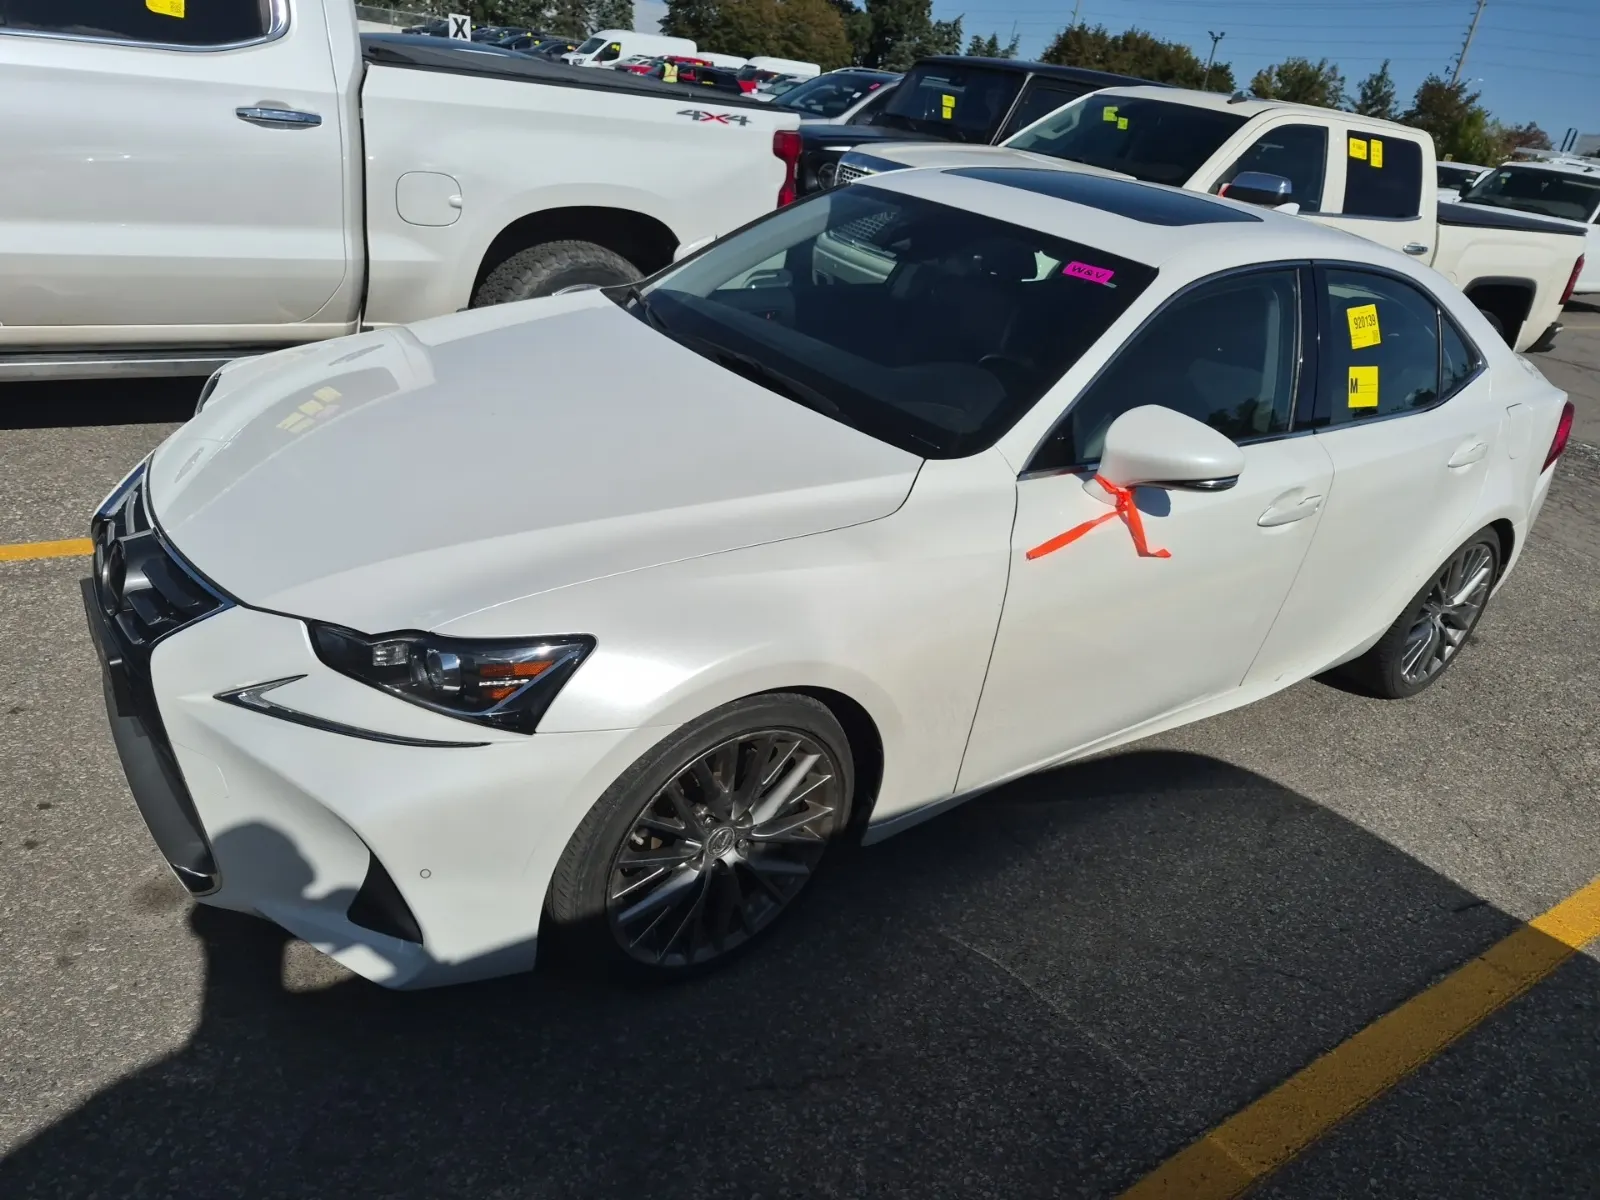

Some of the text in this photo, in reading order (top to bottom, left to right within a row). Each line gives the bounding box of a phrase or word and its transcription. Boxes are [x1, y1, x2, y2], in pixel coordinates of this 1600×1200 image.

[452, 17, 468, 39] X
[1353, 313, 1377, 330] 920139
[1350, 377, 1358, 394] M
